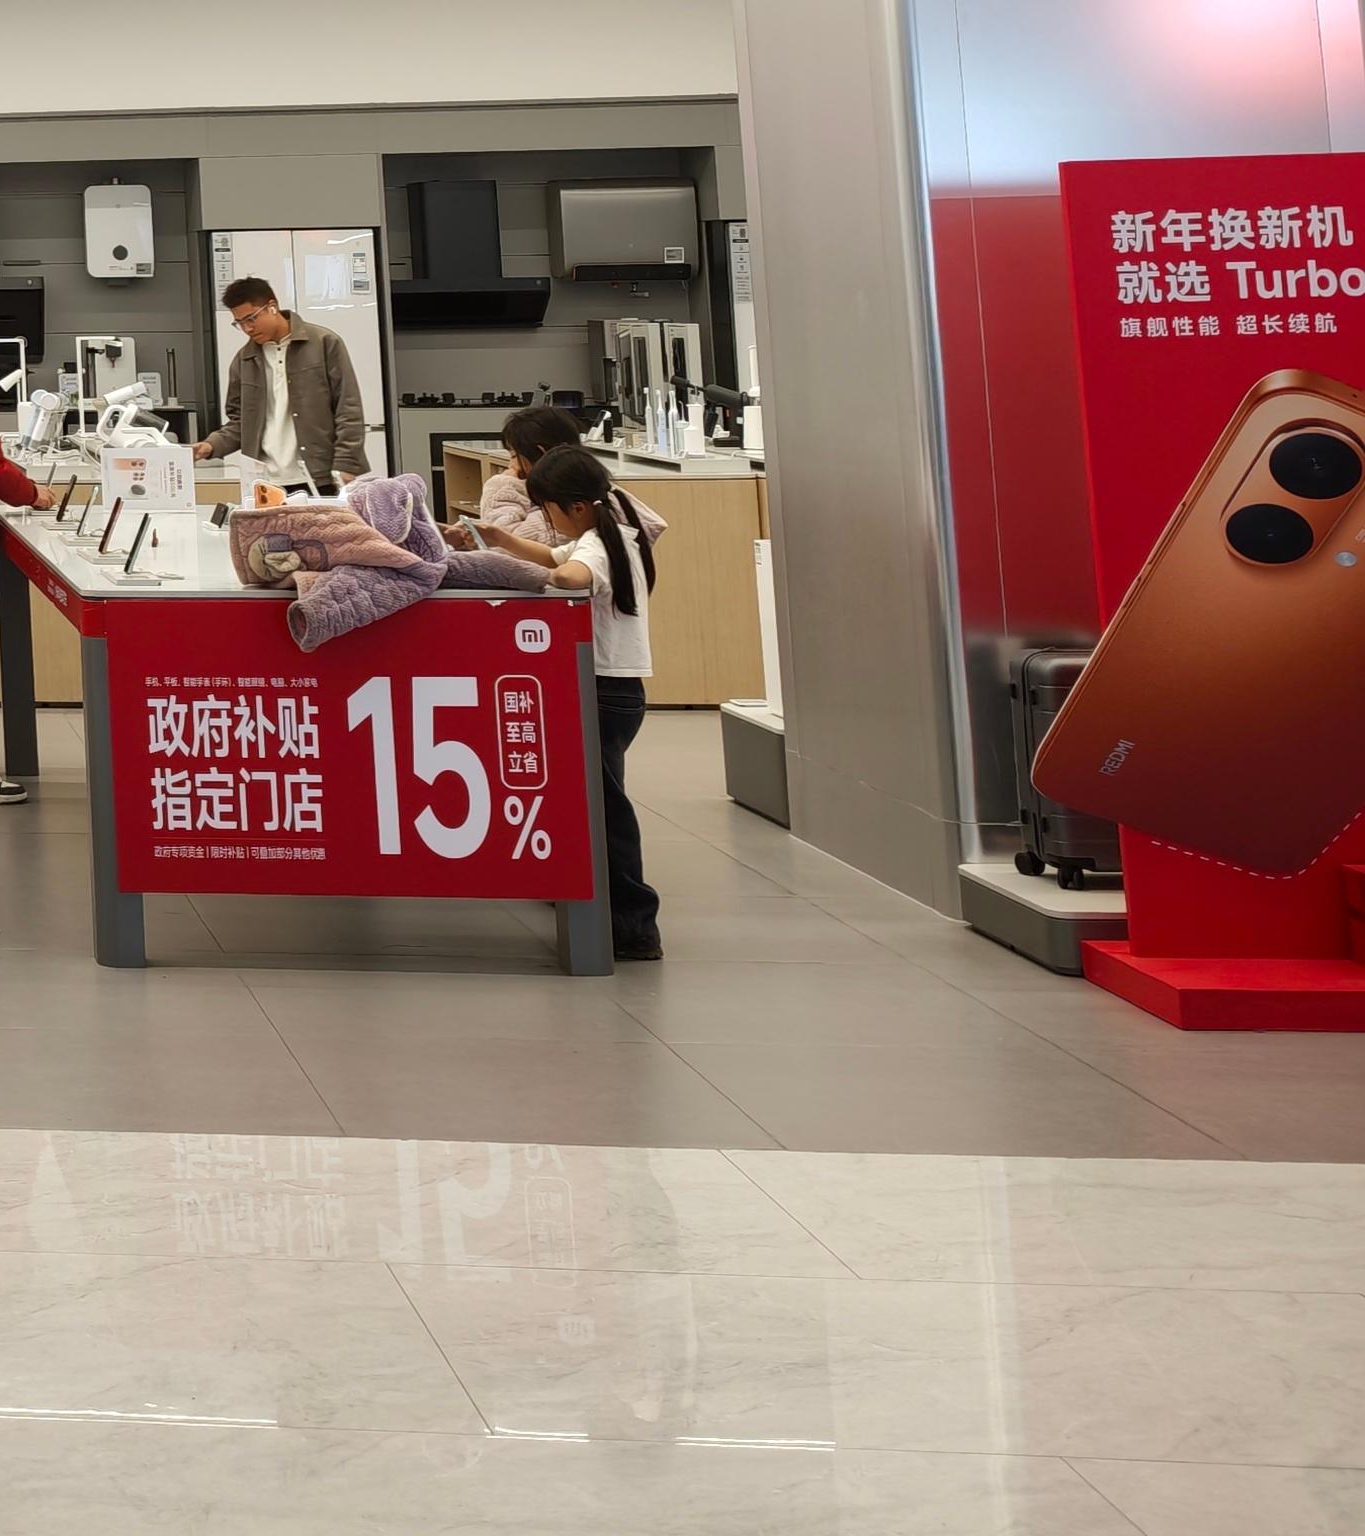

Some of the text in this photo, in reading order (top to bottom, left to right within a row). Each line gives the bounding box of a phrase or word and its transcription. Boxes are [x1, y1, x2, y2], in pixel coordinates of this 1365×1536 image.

[1110, 205, 1354, 254] 新年换新机
[1116, 259, 1365, 305] 就选 Turbo
[1120, 312, 1338, 338] 旗舰性能 超长续航
[504, 691, 534, 714] 国补
[147, 693, 321, 760] 政府补贴
[506, 721, 536, 744] 至高
[347, 676, 492, 859] 15
[507, 750, 539, 775] 立省
[1099, 739, 1136, 776] REDMI
[150, 766, 324, 833] 指定门店
